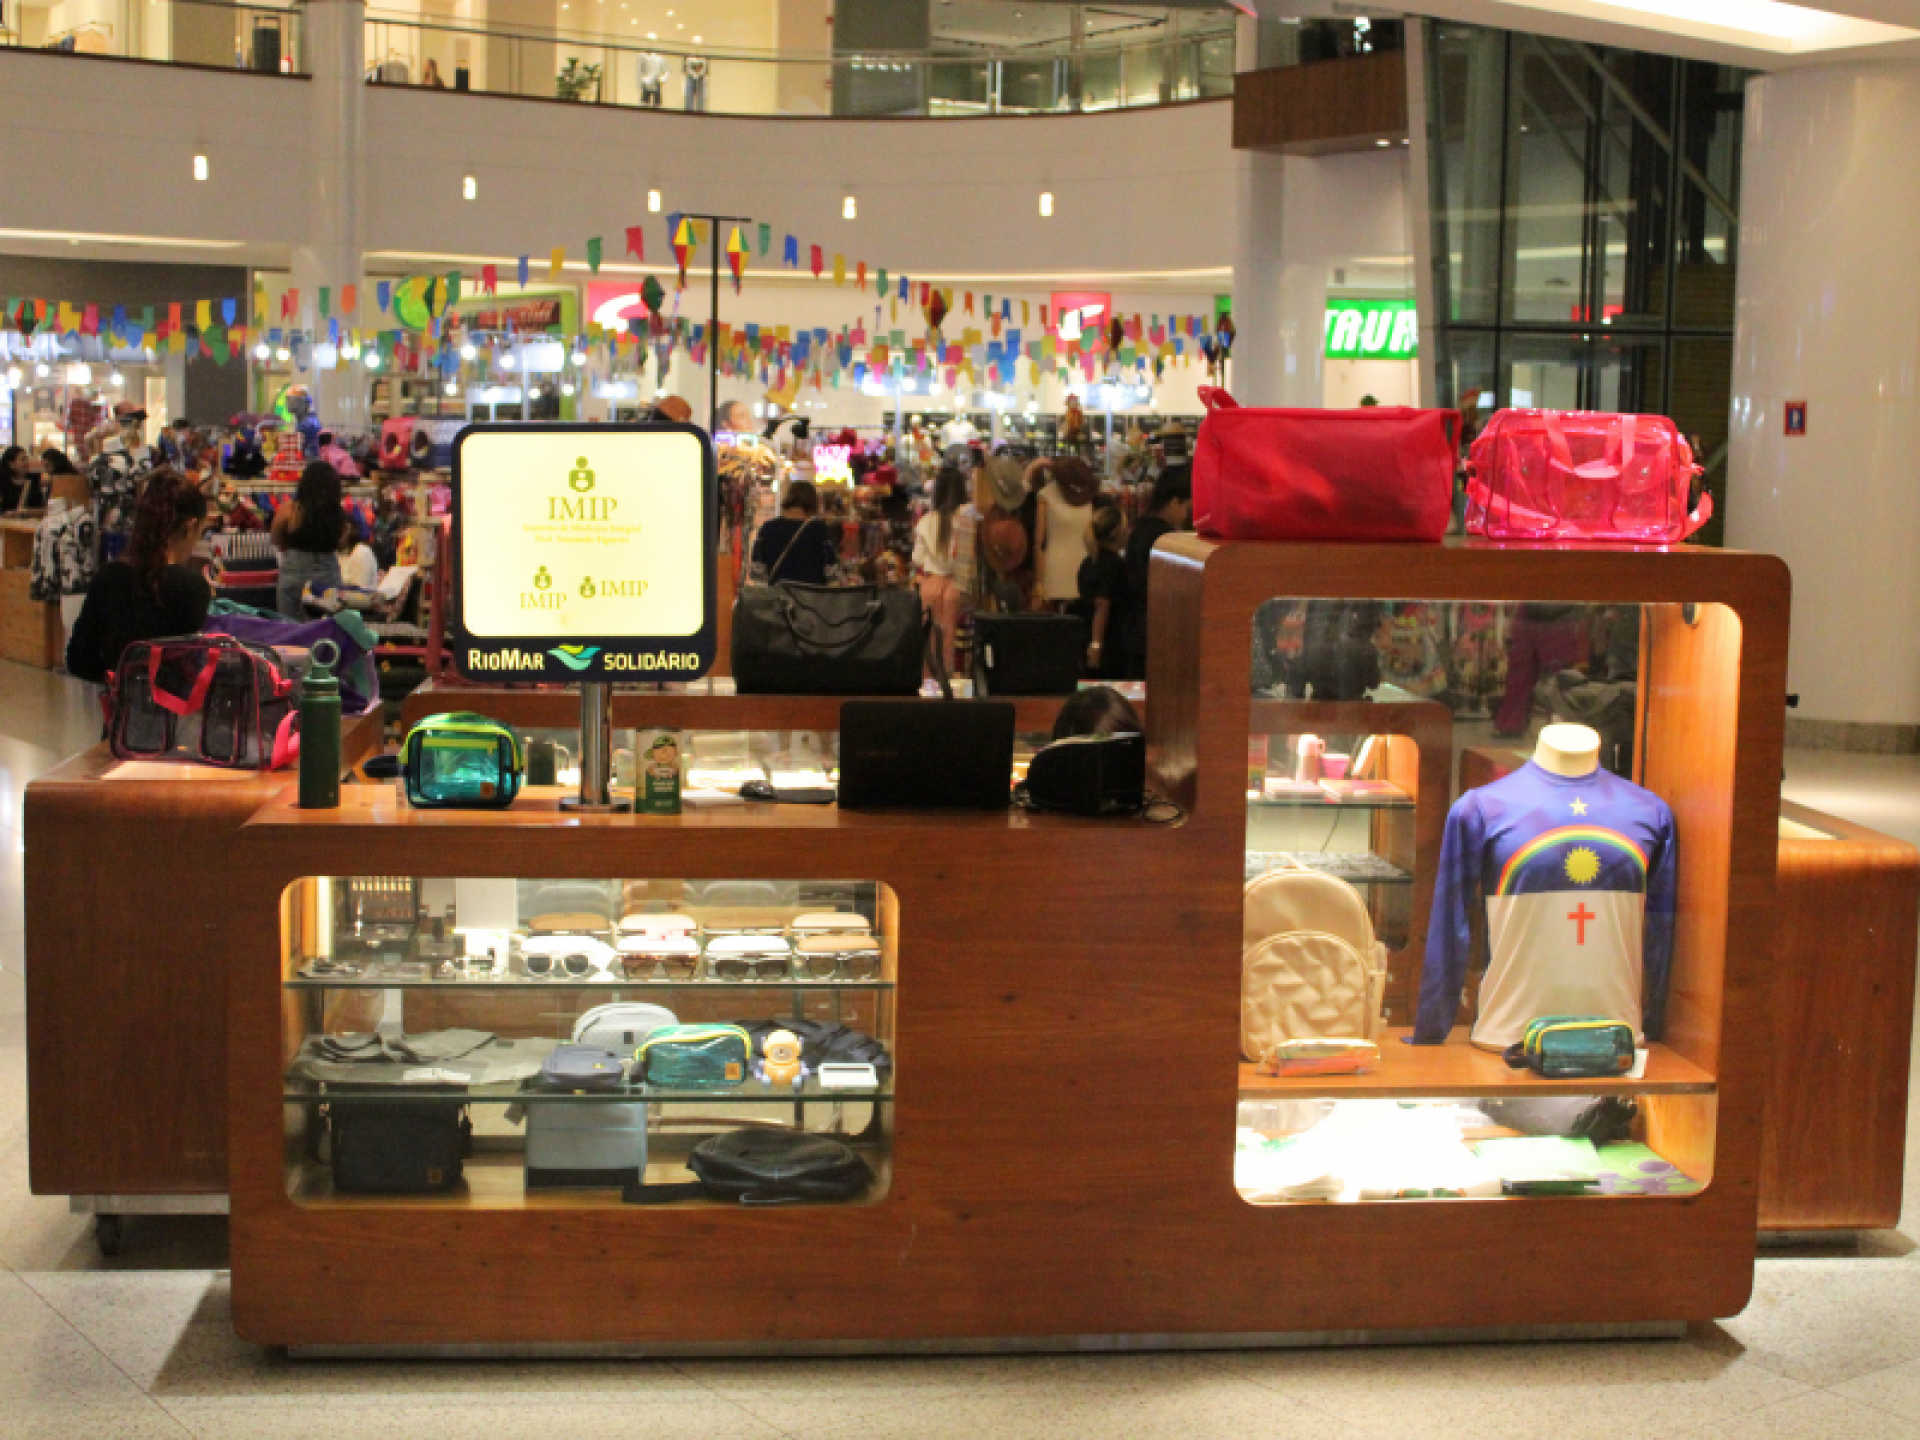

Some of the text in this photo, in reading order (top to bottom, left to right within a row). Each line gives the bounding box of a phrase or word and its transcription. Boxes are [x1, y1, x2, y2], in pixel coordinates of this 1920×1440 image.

[547, 496, 618, 521] IMIP
[601, 579, 648, 598] IMIP
[519, 592, 567, 610] IMIP
[603, 649, 700, 671] SOLIDÁRIO
